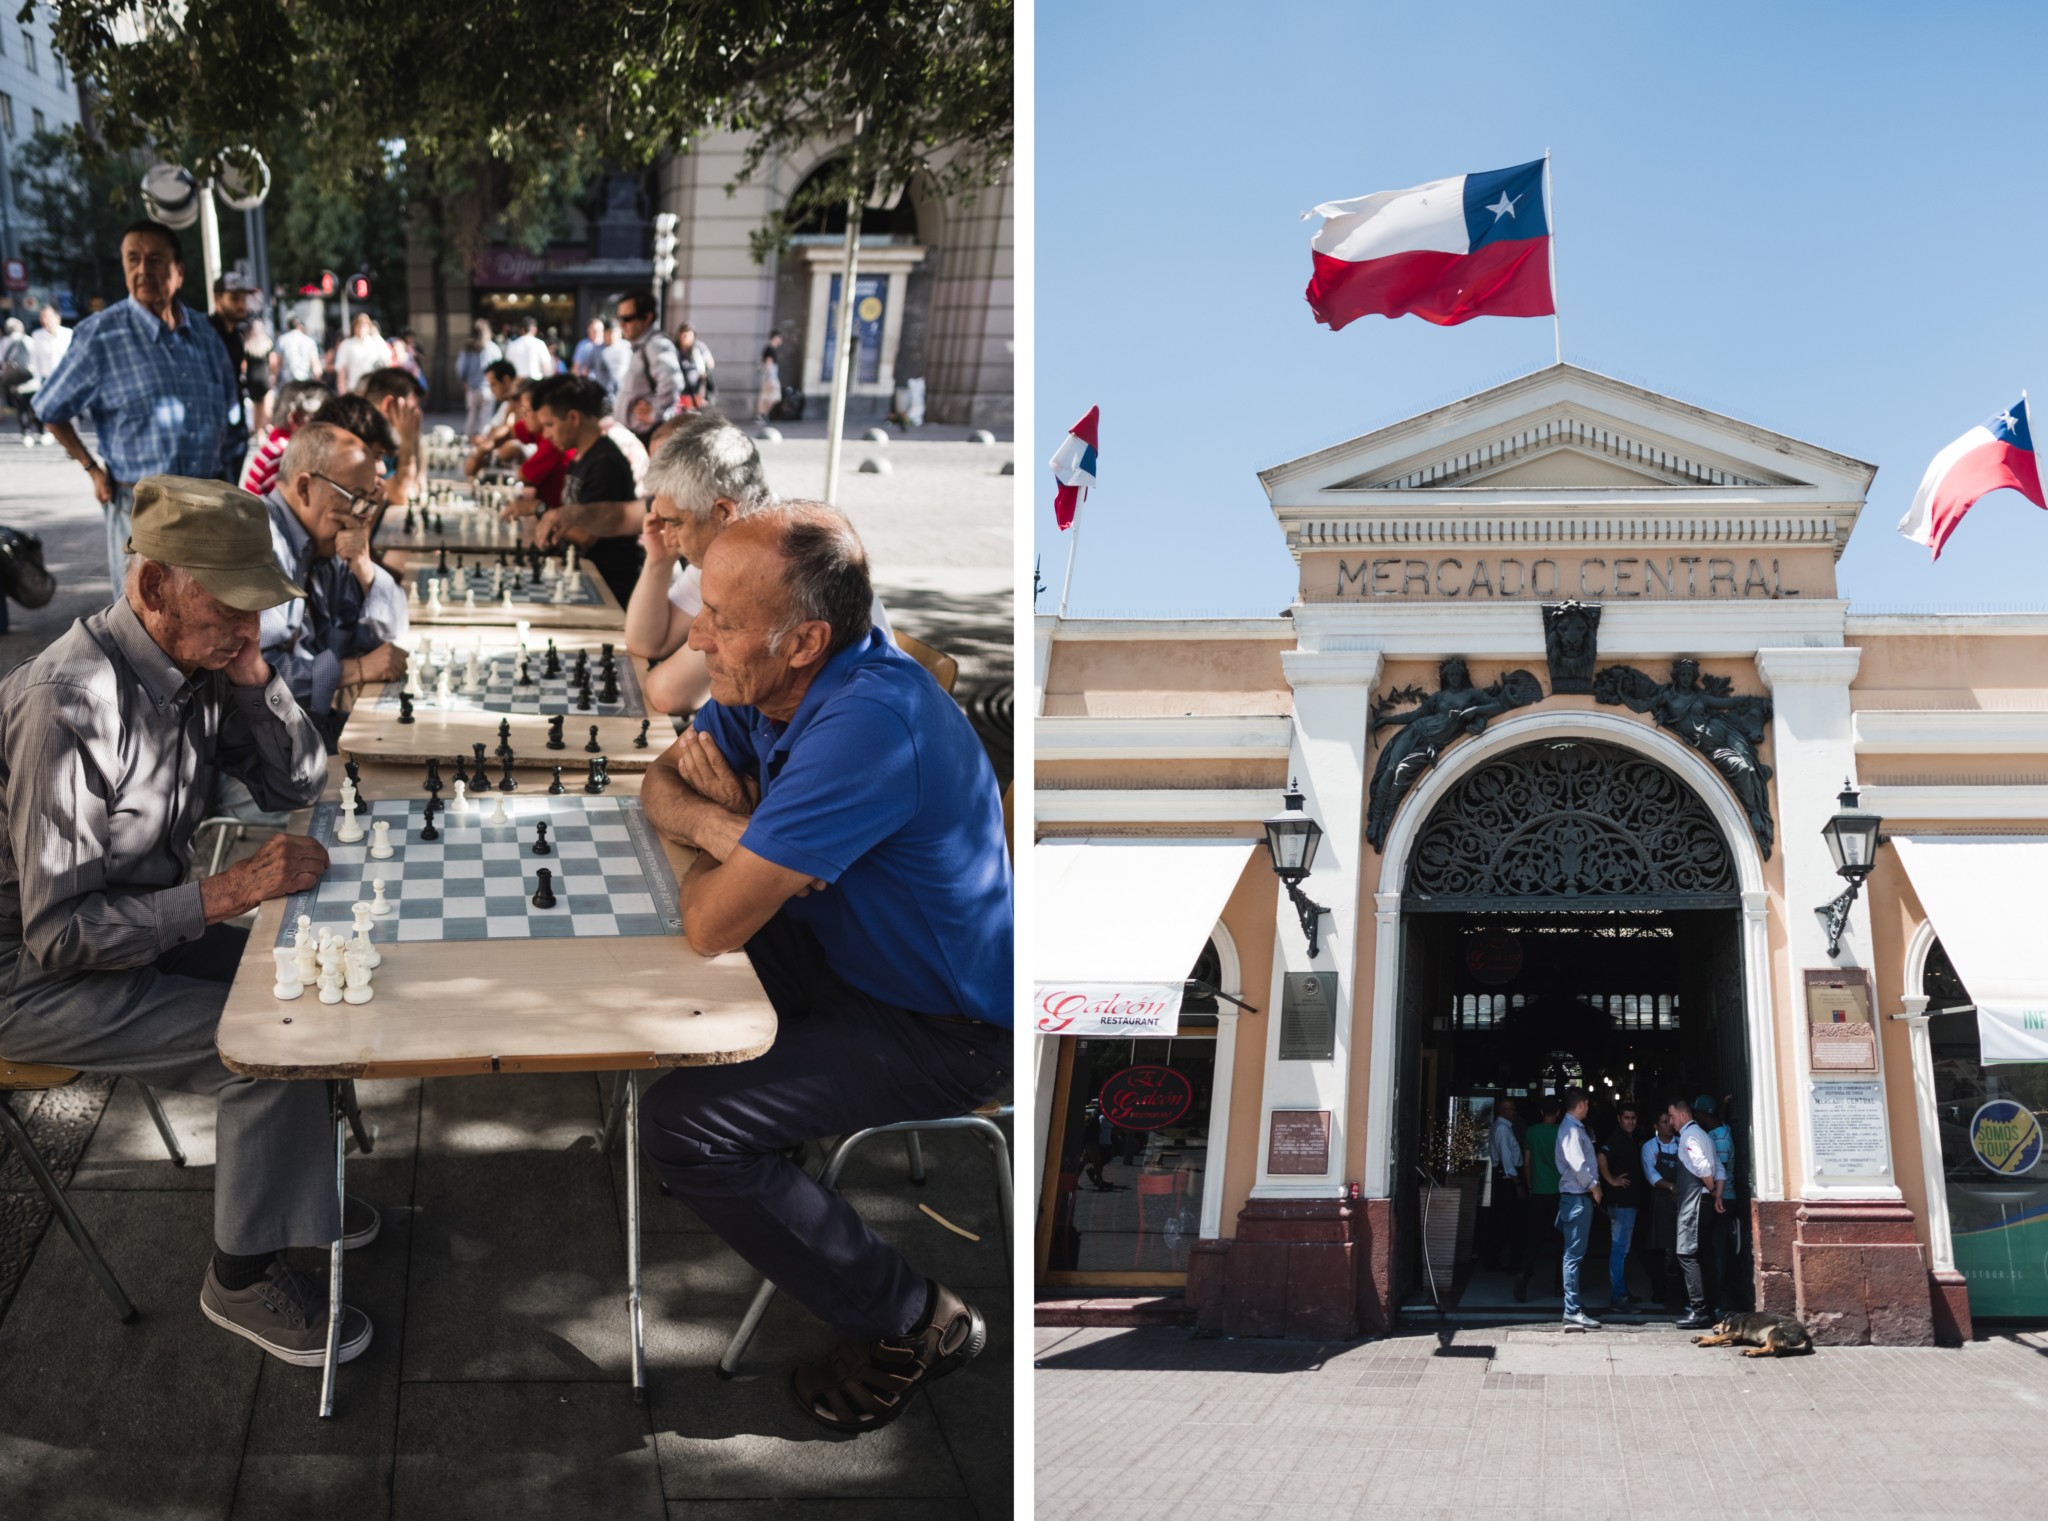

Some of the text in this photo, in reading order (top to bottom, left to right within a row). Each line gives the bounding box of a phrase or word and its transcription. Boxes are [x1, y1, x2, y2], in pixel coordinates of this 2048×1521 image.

[1337, 556, 1800, 596] MERCADO CENTRAL
[647, 857, 660, 871] PLAZA
[664, 899, 676, 914] CLUB
[1038, 991, 1166, 1032] Galeón
[1100, 1016, 1160, 1026] RESTAURANT
[2023, 1010, 2048, 1030] INF
[1127, 1071, 1168, 1087] El
[1111, 1089, 1183, 1118] Galeón
[1979, 1124, 2020, 1141] SOMOS
[1979, 1141, 2011, 1157] TOUR
[1965, 1270, 2023, 1280] OSTOUR.CL
